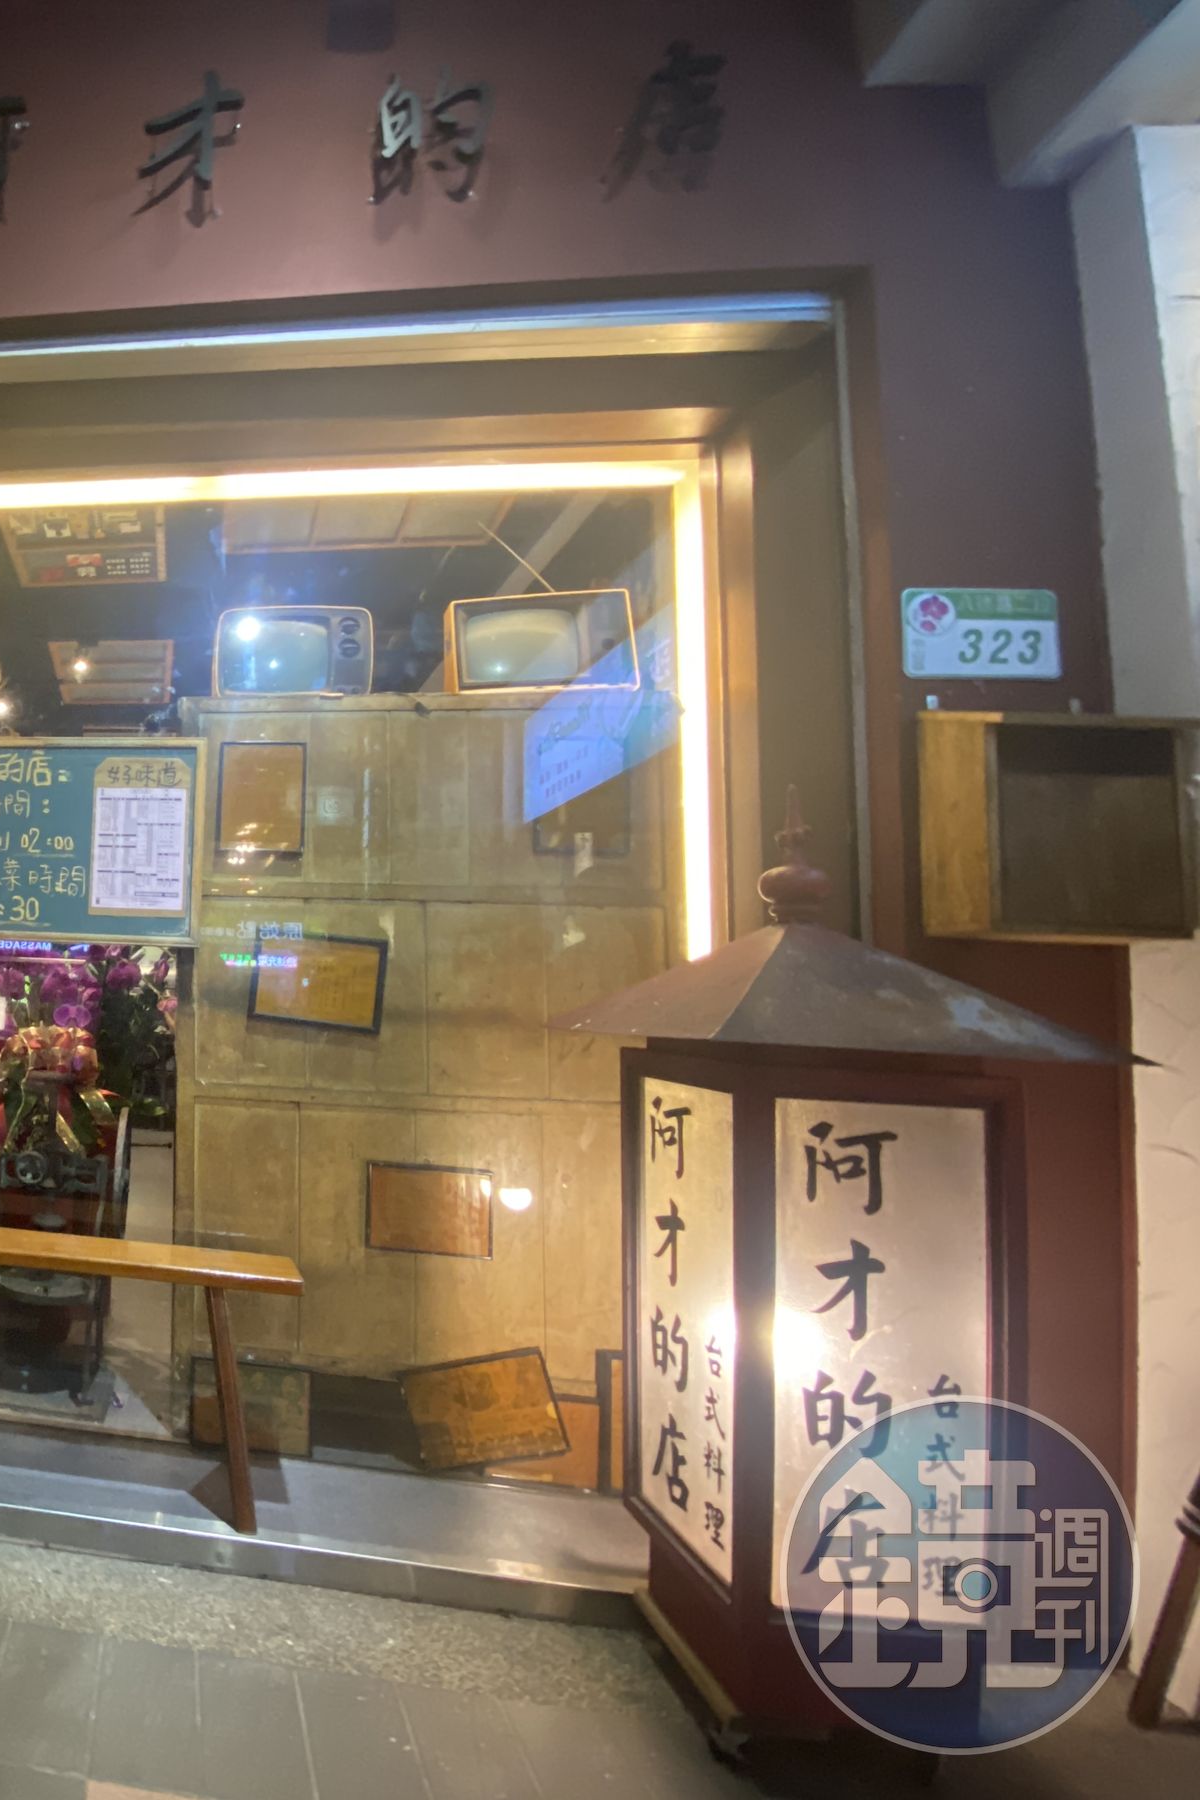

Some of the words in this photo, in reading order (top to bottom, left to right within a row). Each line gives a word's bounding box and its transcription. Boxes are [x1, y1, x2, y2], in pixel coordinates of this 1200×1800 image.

[958, 628, 1042, 665] 323
[107, 762, 182, 787] 好味道
[20, 827, 74, 853] 02:00
[649, 1096, 692, 1513] 阿才的店
[800, 1121, 898, 1590] 阿才的店
[703, 1334, 727, 1552] 台式料理
